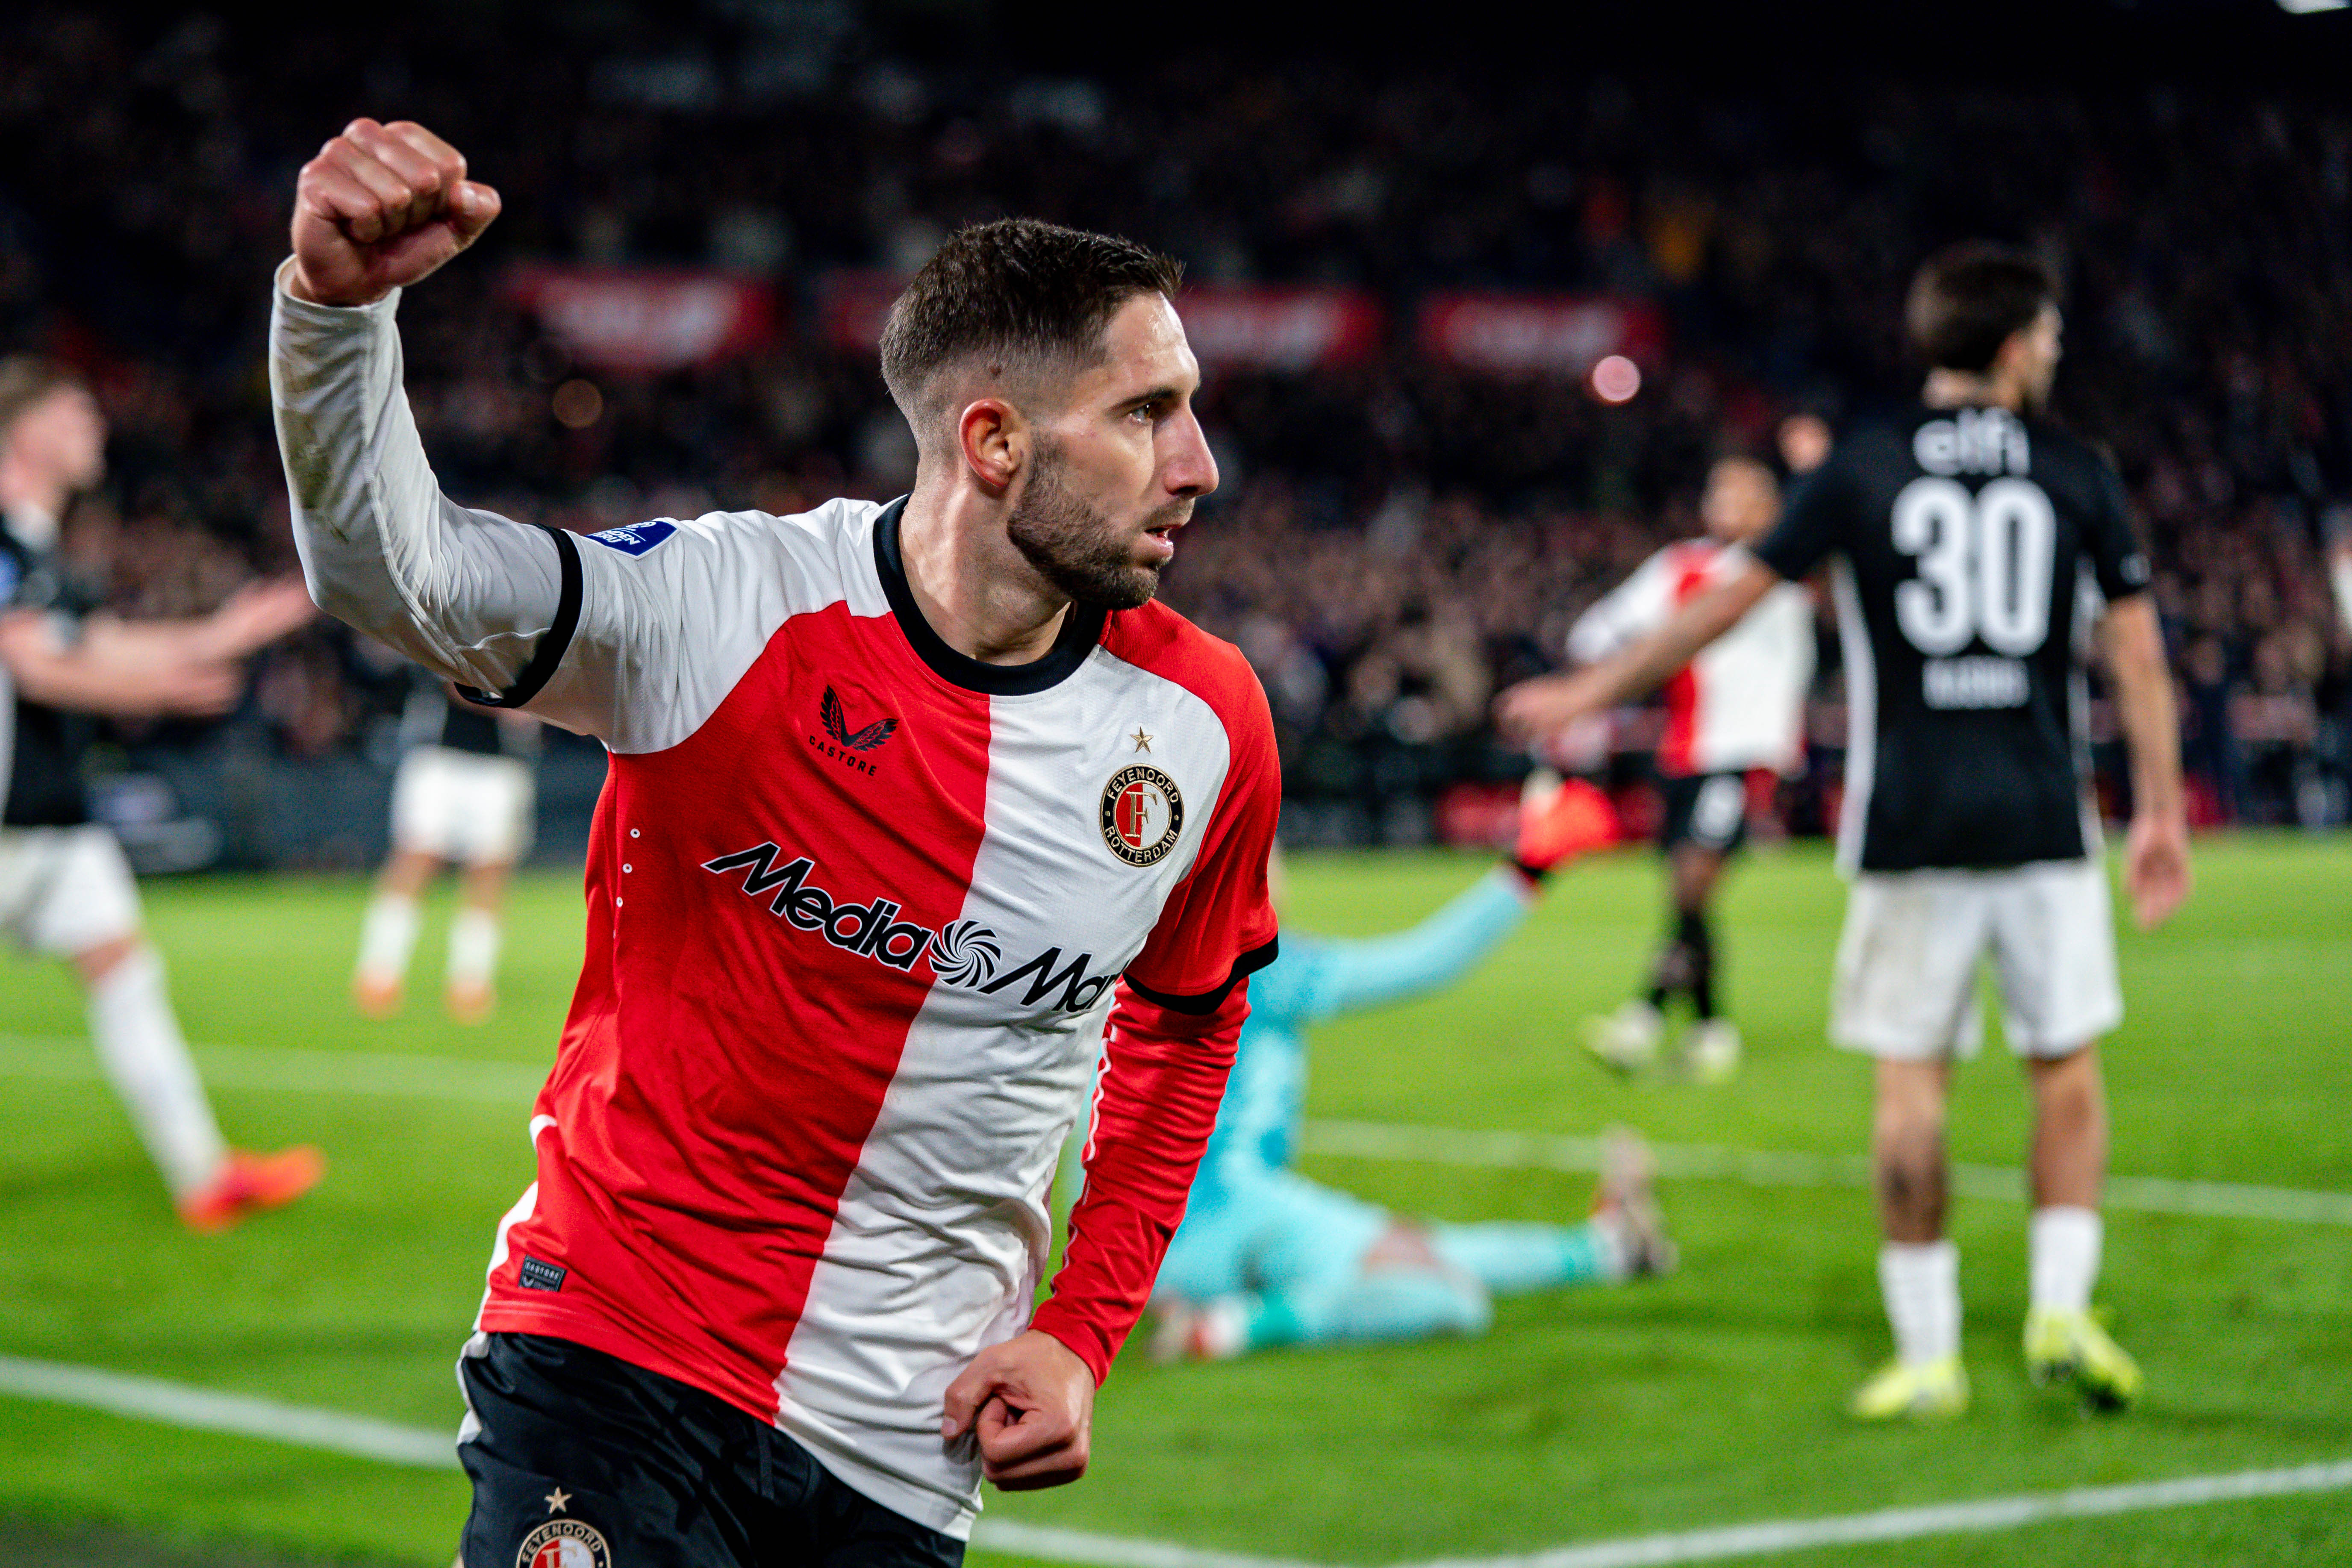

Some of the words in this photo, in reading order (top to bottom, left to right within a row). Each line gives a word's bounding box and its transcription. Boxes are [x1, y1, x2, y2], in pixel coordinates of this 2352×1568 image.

[1892, 477, 2056, 657] 30
[809, 735, 877, 776] CASTORE
[1107, 768, 1179, 803] FEYENOORD
[1125, 791, 1158, 838] F
[1105, 825, 1177, 863] ROTTERDAM
[701, 841, 935, 973] Media
[976, 946, 1131, 1013] Mar
[522, 1524, 601, 1562] FEYENOORD
